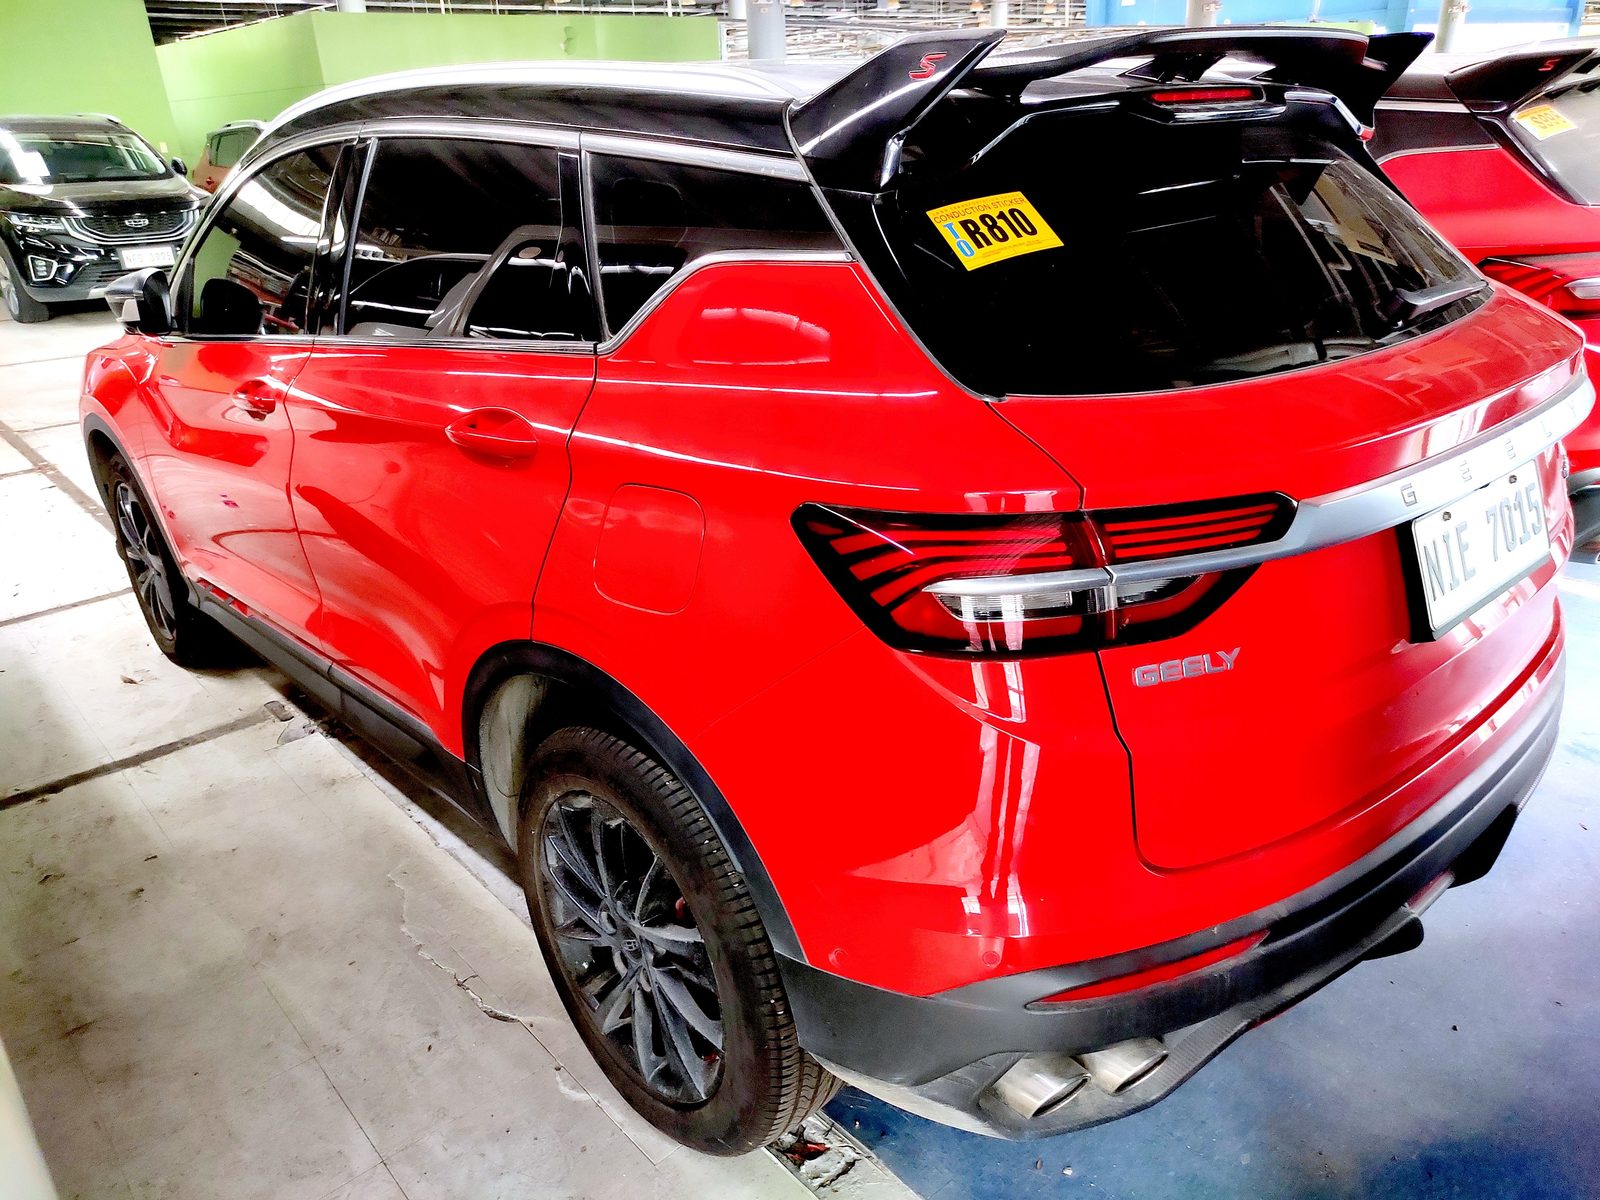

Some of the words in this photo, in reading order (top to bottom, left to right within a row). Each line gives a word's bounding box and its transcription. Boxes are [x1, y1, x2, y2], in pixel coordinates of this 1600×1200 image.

[908, 52, 947, 79] S
[933, 203, 992, 224] CONDUCTION
[991, 197, 1025, 210] STICKER
[958, 207, 1038, 249] R810
[1423, 520, 1477, 602] NIE
[1485, 482, 1543, 563] 7015
[1133, 647, 1241, 687] GEELY
